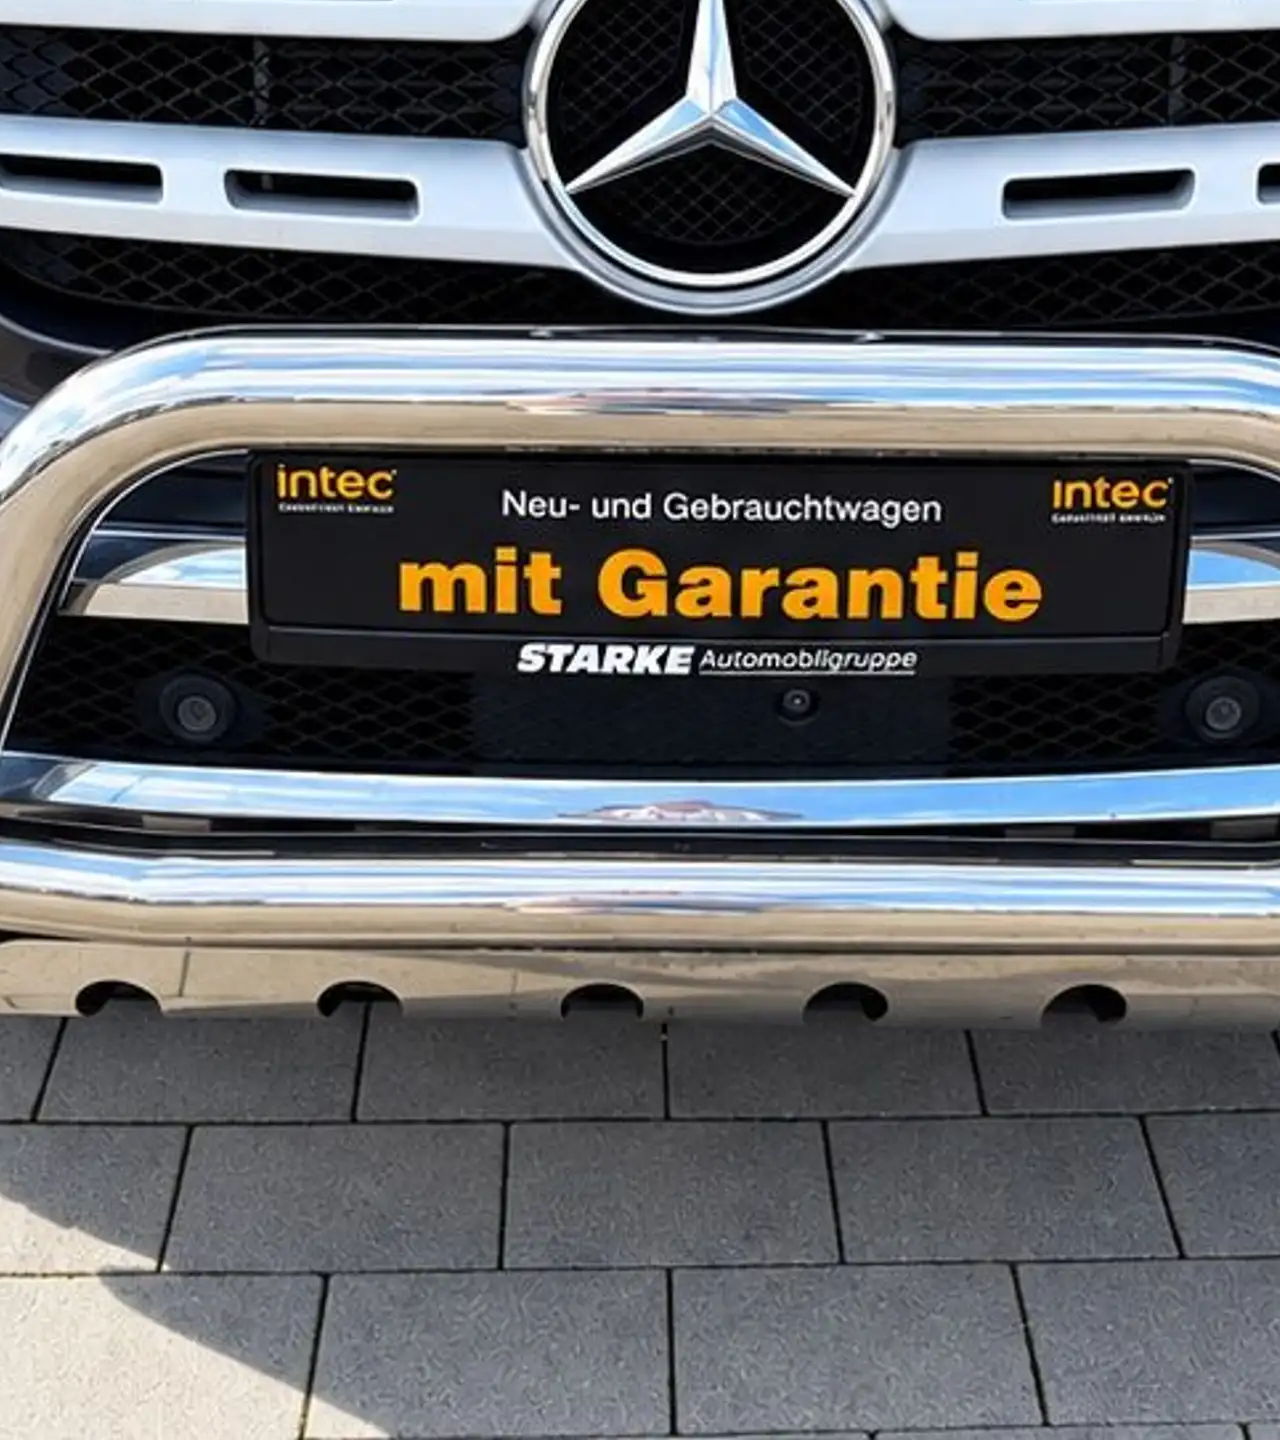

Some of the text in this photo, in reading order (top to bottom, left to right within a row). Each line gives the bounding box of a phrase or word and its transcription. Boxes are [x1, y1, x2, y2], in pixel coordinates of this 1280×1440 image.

[276, 464, 393, 499] intec
[1052, 476, 1168, 509] intec
[502, 490, 942, 528] Neu- und Gebrauchtwagen
[399, 545, 1042, 621] mit Garantie
[517, 643, 918, 675] STARKE Automobilgruppe
